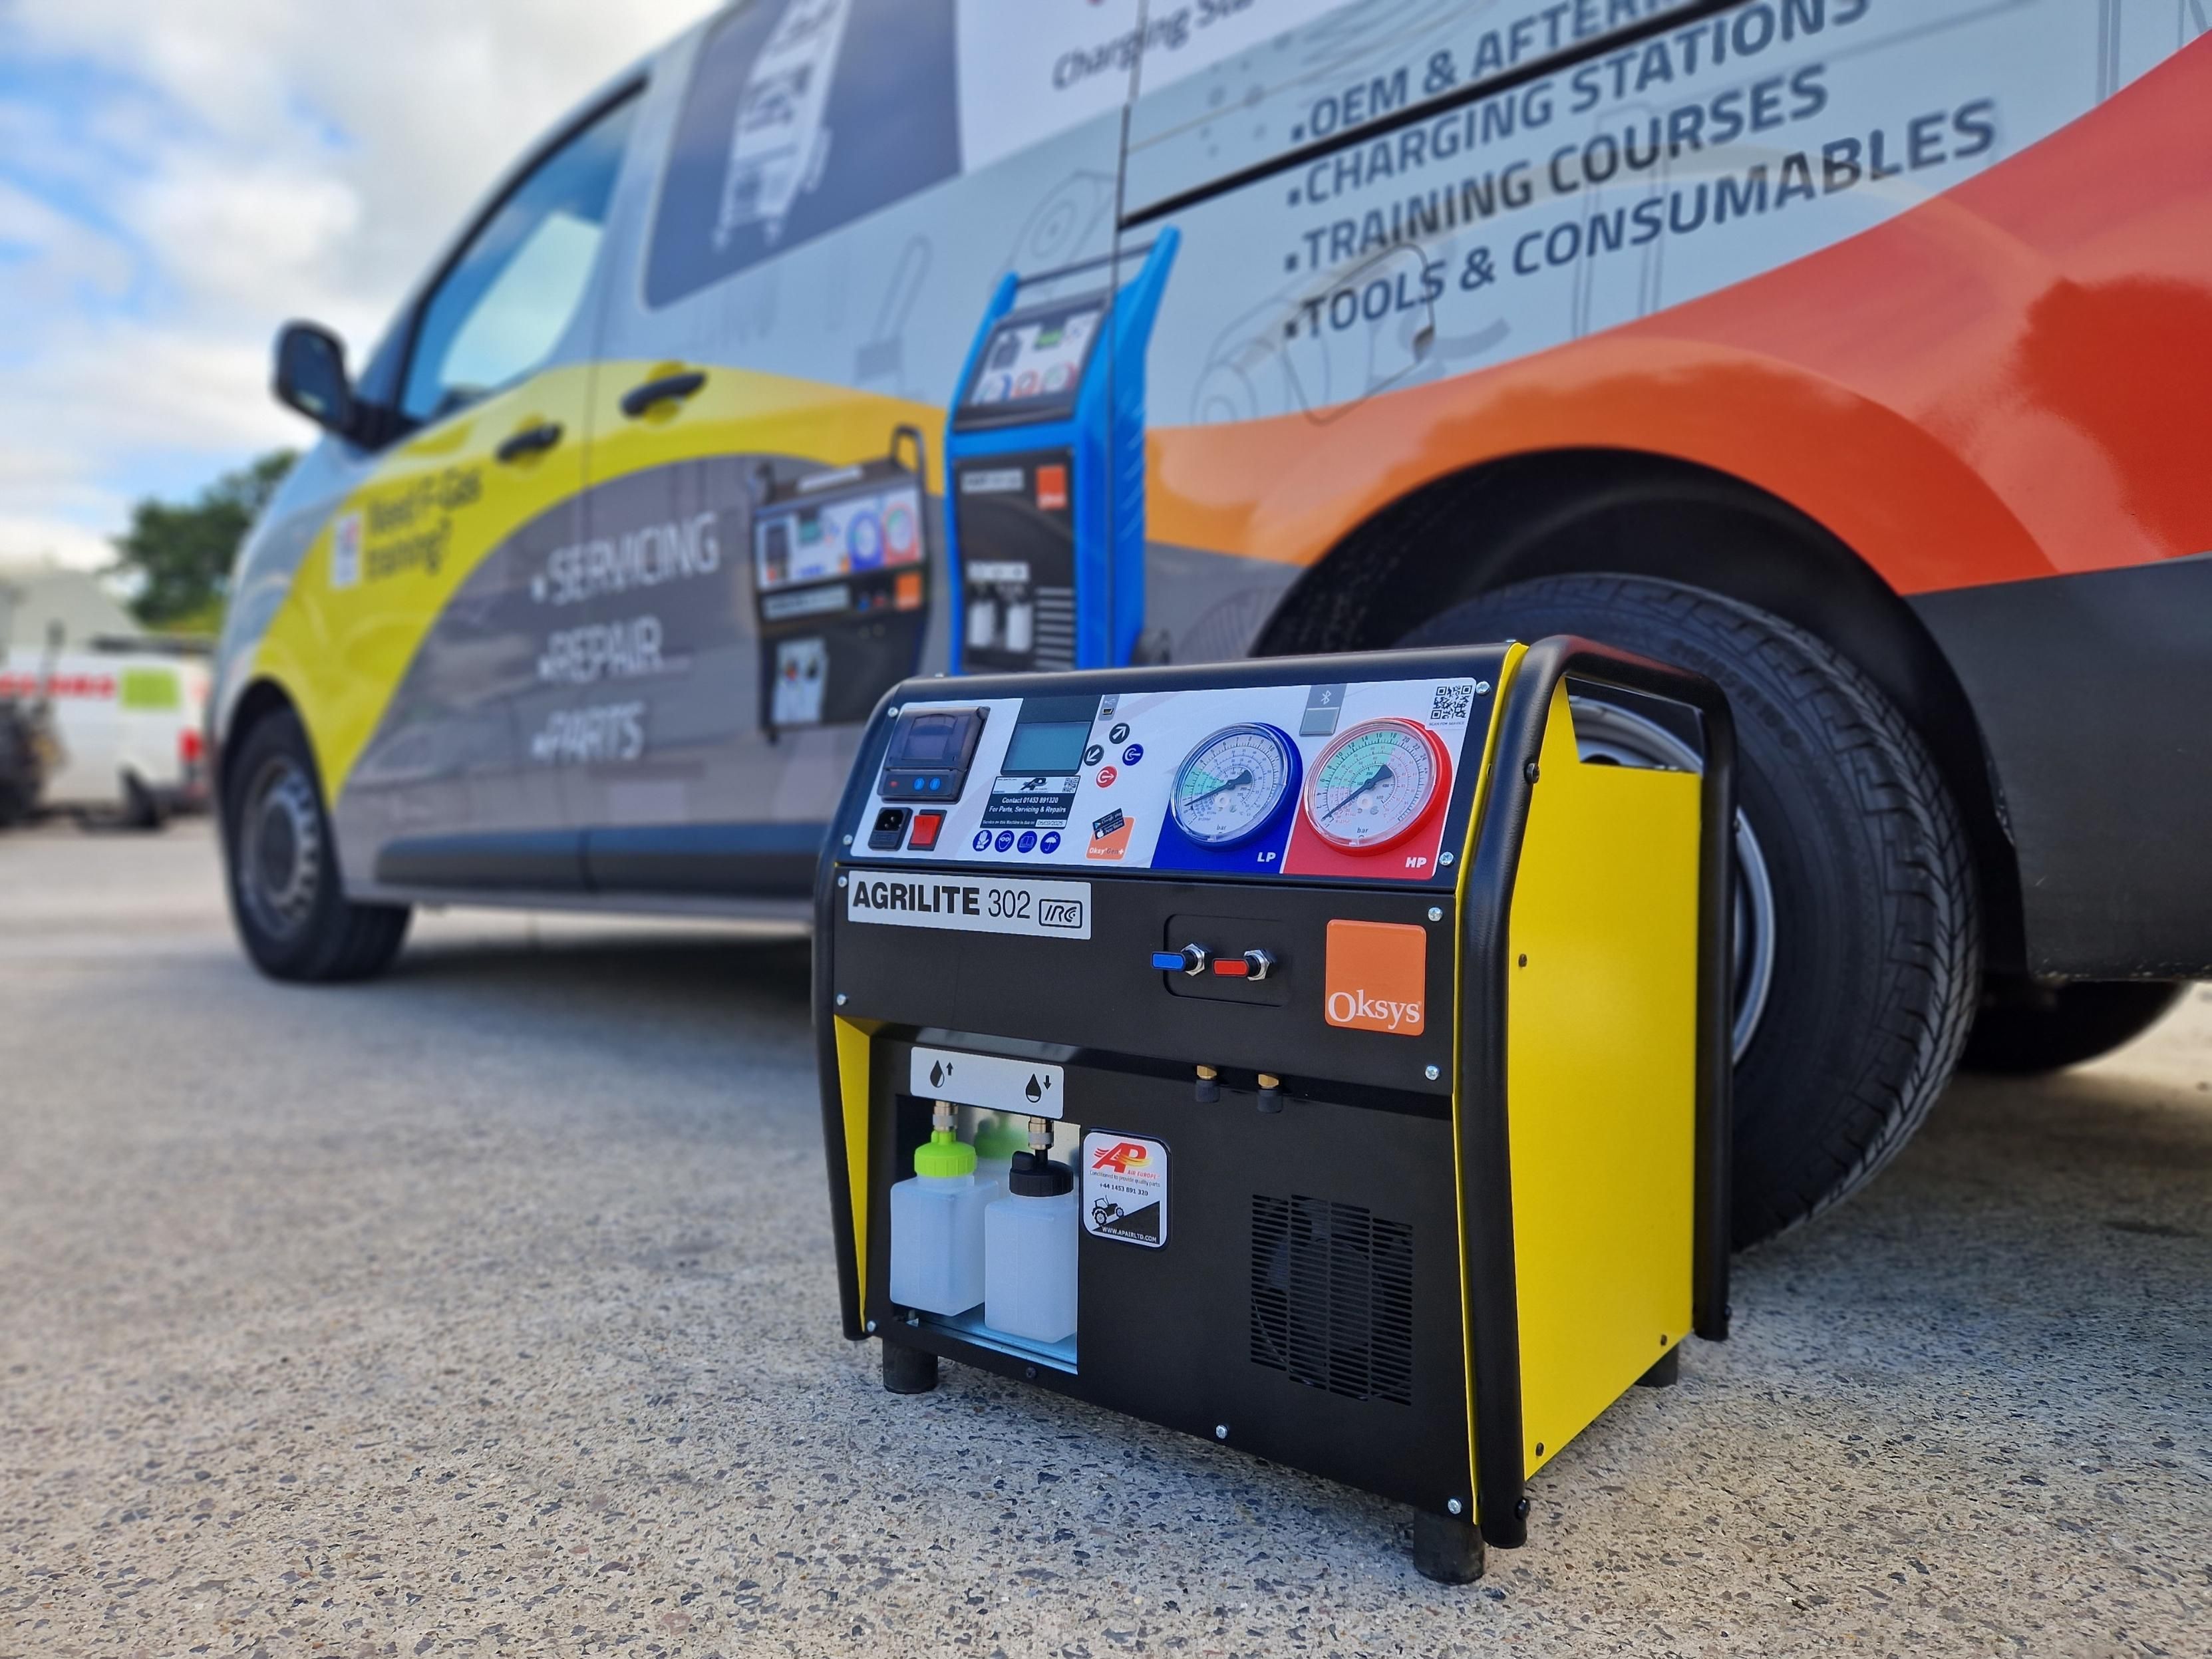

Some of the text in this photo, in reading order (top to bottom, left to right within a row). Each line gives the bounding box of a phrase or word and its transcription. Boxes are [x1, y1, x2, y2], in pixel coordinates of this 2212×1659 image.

[1311, 66, 1408, 137] OEM
[1423, 48, 1458, 95] &
[1306, 80, 1553, 204] CHARGING
[1303, 63, 1828, 270] TRAINING COURSES
[1302, 97, 1996, 338] TOOLS & CONSUMABLES
[547, 510, 720, 606] SERVICING
[548, 613, 664, 683] REPAIR
[546, 699, 646, 762] PARTS
[1015, 806, 1039, 814] Servicing
[1257, 852, 1277, 862] LP
[1405, 857, 1427, 868] HP
[853, 881, 980, 915] AGRILITE
[988, 889, 1030, 919] 302
[1328, 989, 1421, 1030] Oksys
[1090, 1170, 1113, 1179] Conditioned
[1092, 1142, 1148, 1173] AP
[1102, 1225, 1157, 1243] WWW.APAIRLTD.COM
